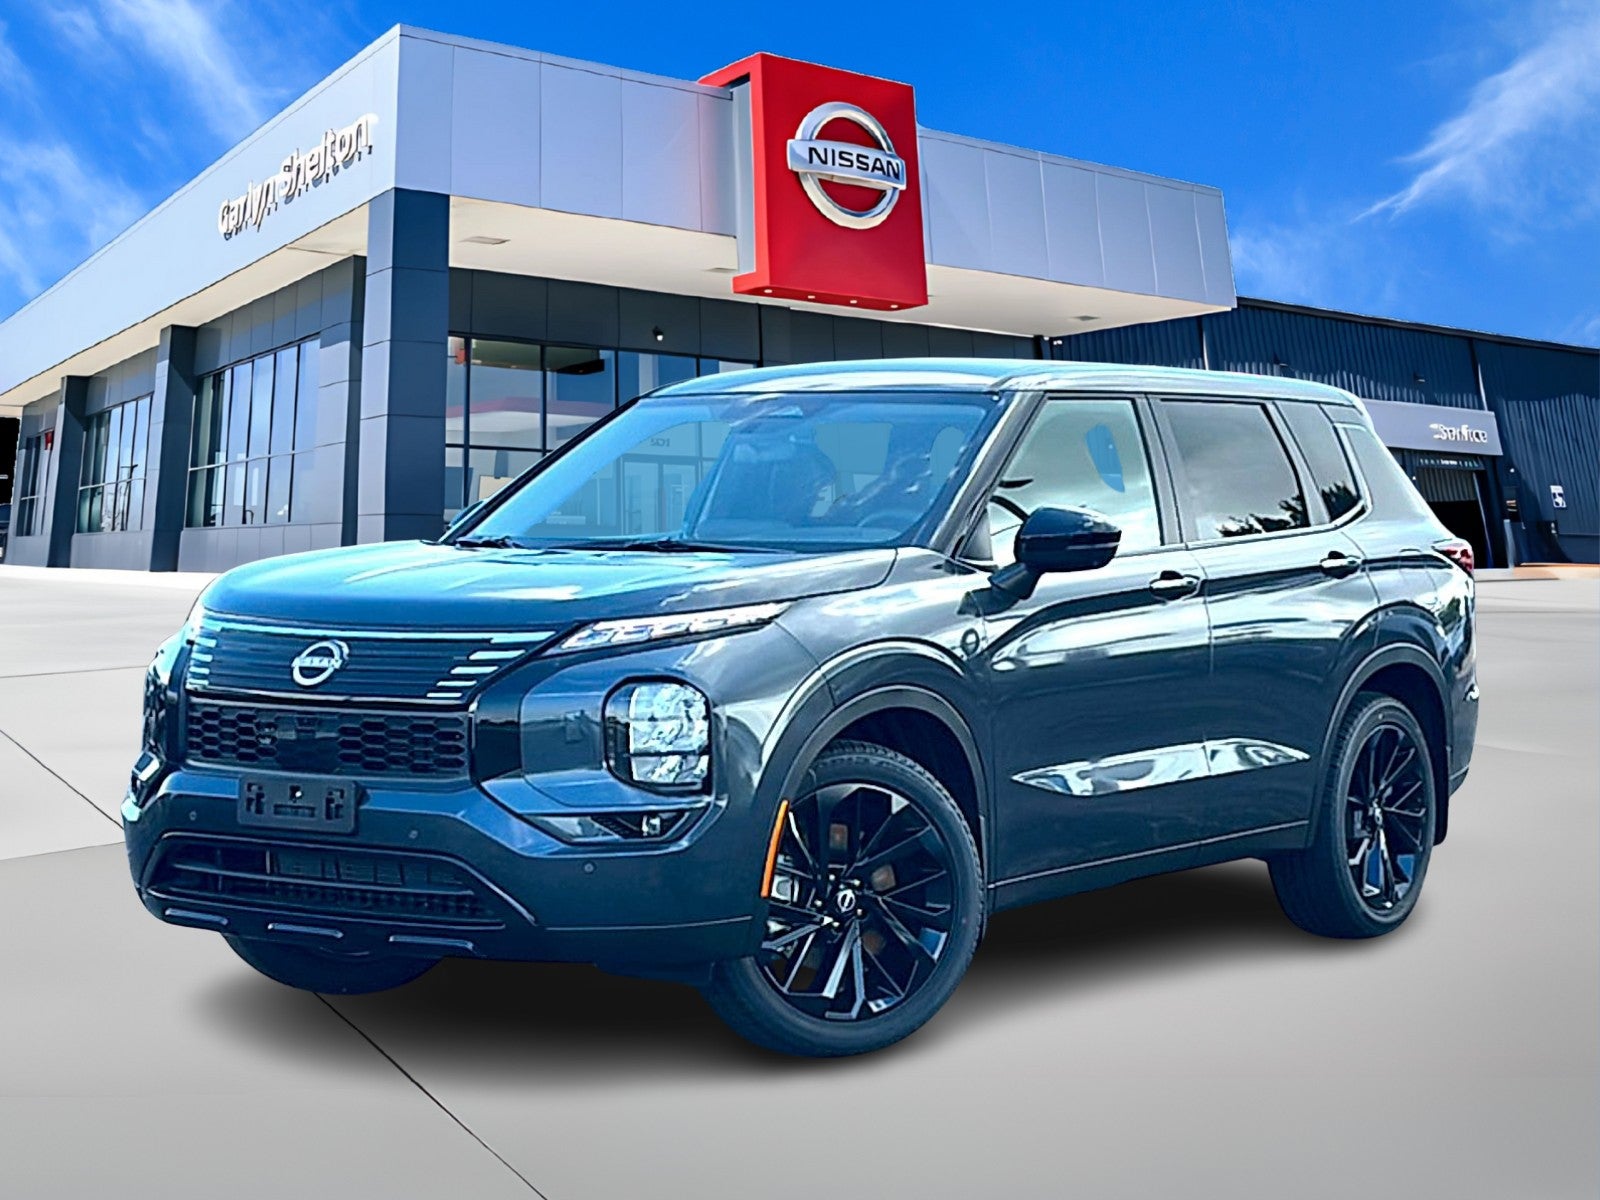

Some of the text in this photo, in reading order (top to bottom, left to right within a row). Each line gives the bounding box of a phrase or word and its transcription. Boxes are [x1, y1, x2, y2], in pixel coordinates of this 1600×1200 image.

[278, 114, 374, 204] Shelton
[808, 147, 900, 179] NISSAN
[1429, 423, 1488, 443] Service
